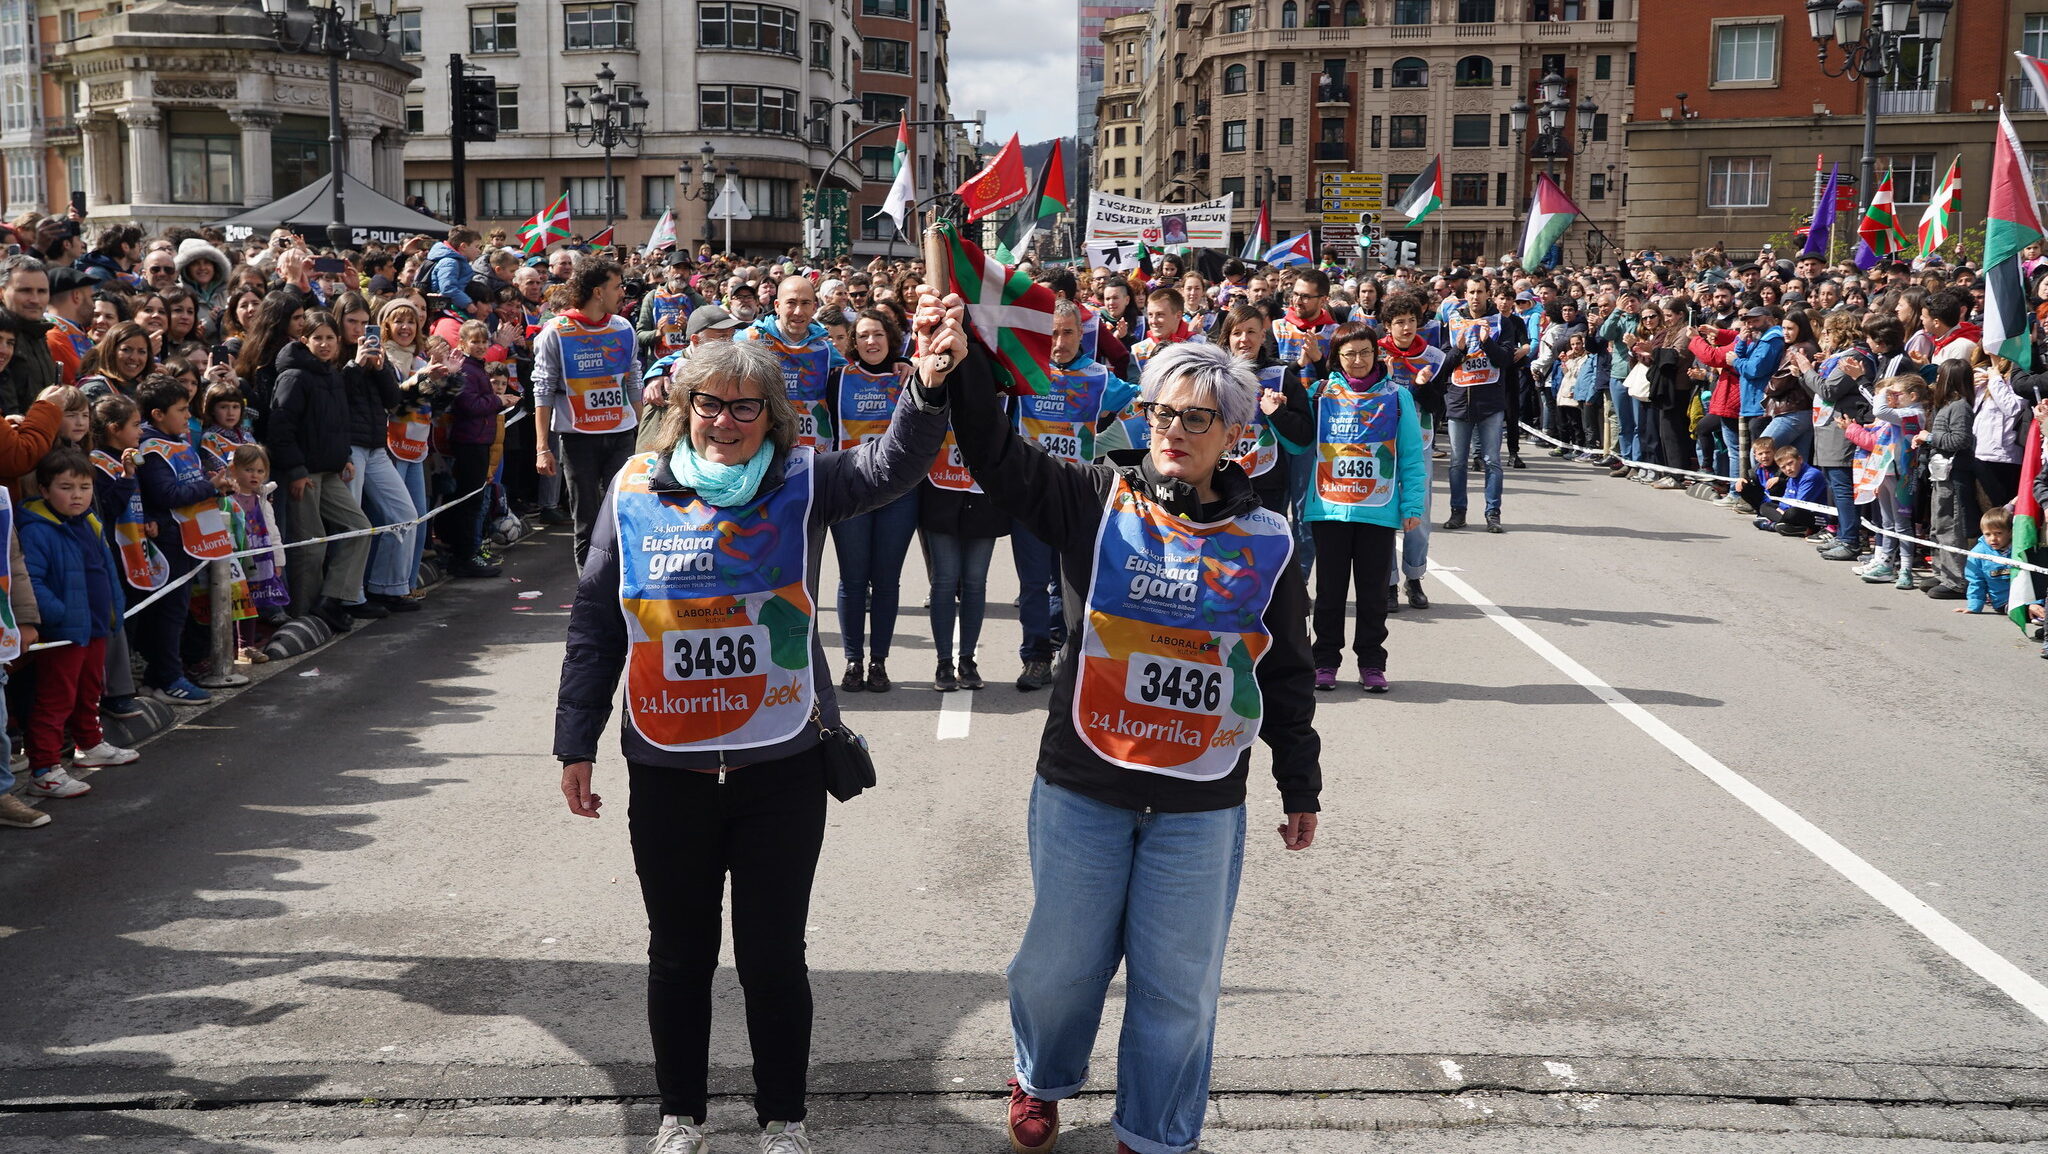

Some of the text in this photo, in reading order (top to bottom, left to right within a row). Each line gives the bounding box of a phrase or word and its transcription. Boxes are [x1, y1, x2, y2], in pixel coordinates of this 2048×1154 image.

[370, 231, 414, 244] PULS
[573, 352, 602, 360] Euskara
[1465, 357, 1488, 371] 3436
[577, 359, 604, 371] gara
[590, 390, 622, 408] 3436
[853, 392, 886, 401] Euskara
[857, 399, 887, 412] gara
[1035, 400, 1065, 412] gara
[574, 411, 620, 424] 24.korrika
[800, 417, 813, 434] 36
[1331, 423, 1359, 435] gara
[1044, 436, 1076, 456] 3436
[1231, 441, 1256, 457] 43
[1338, 460, 1373, 478] 3436
[1155, 484, 1174, 501] HH
[1320, 481, 1368, 494] 24.korrika
[653, 522, 697, 534] 24.korrika
[1252, 510, 1281, 530] eitb
[642, 535, 715, 552] Euskara
[648, 551, 715, 580] gara
[1124, 554, 1199, 582] Euskara
[1128, 574, 1198, 603] gara
[677, 607, 725, 618] LABORAL
[1151, 634, 1198, 650] LABORAL
[673, 633, 757, 679] 3436
[763, 675, 803, 708] aek
[1140, 662, 1222, 712] 3436
[639, 687, 749, 714] 24.korrika
[1088, 709, 1202, 747] 24.korrika
[1210, 722, 1245, 750] aek
